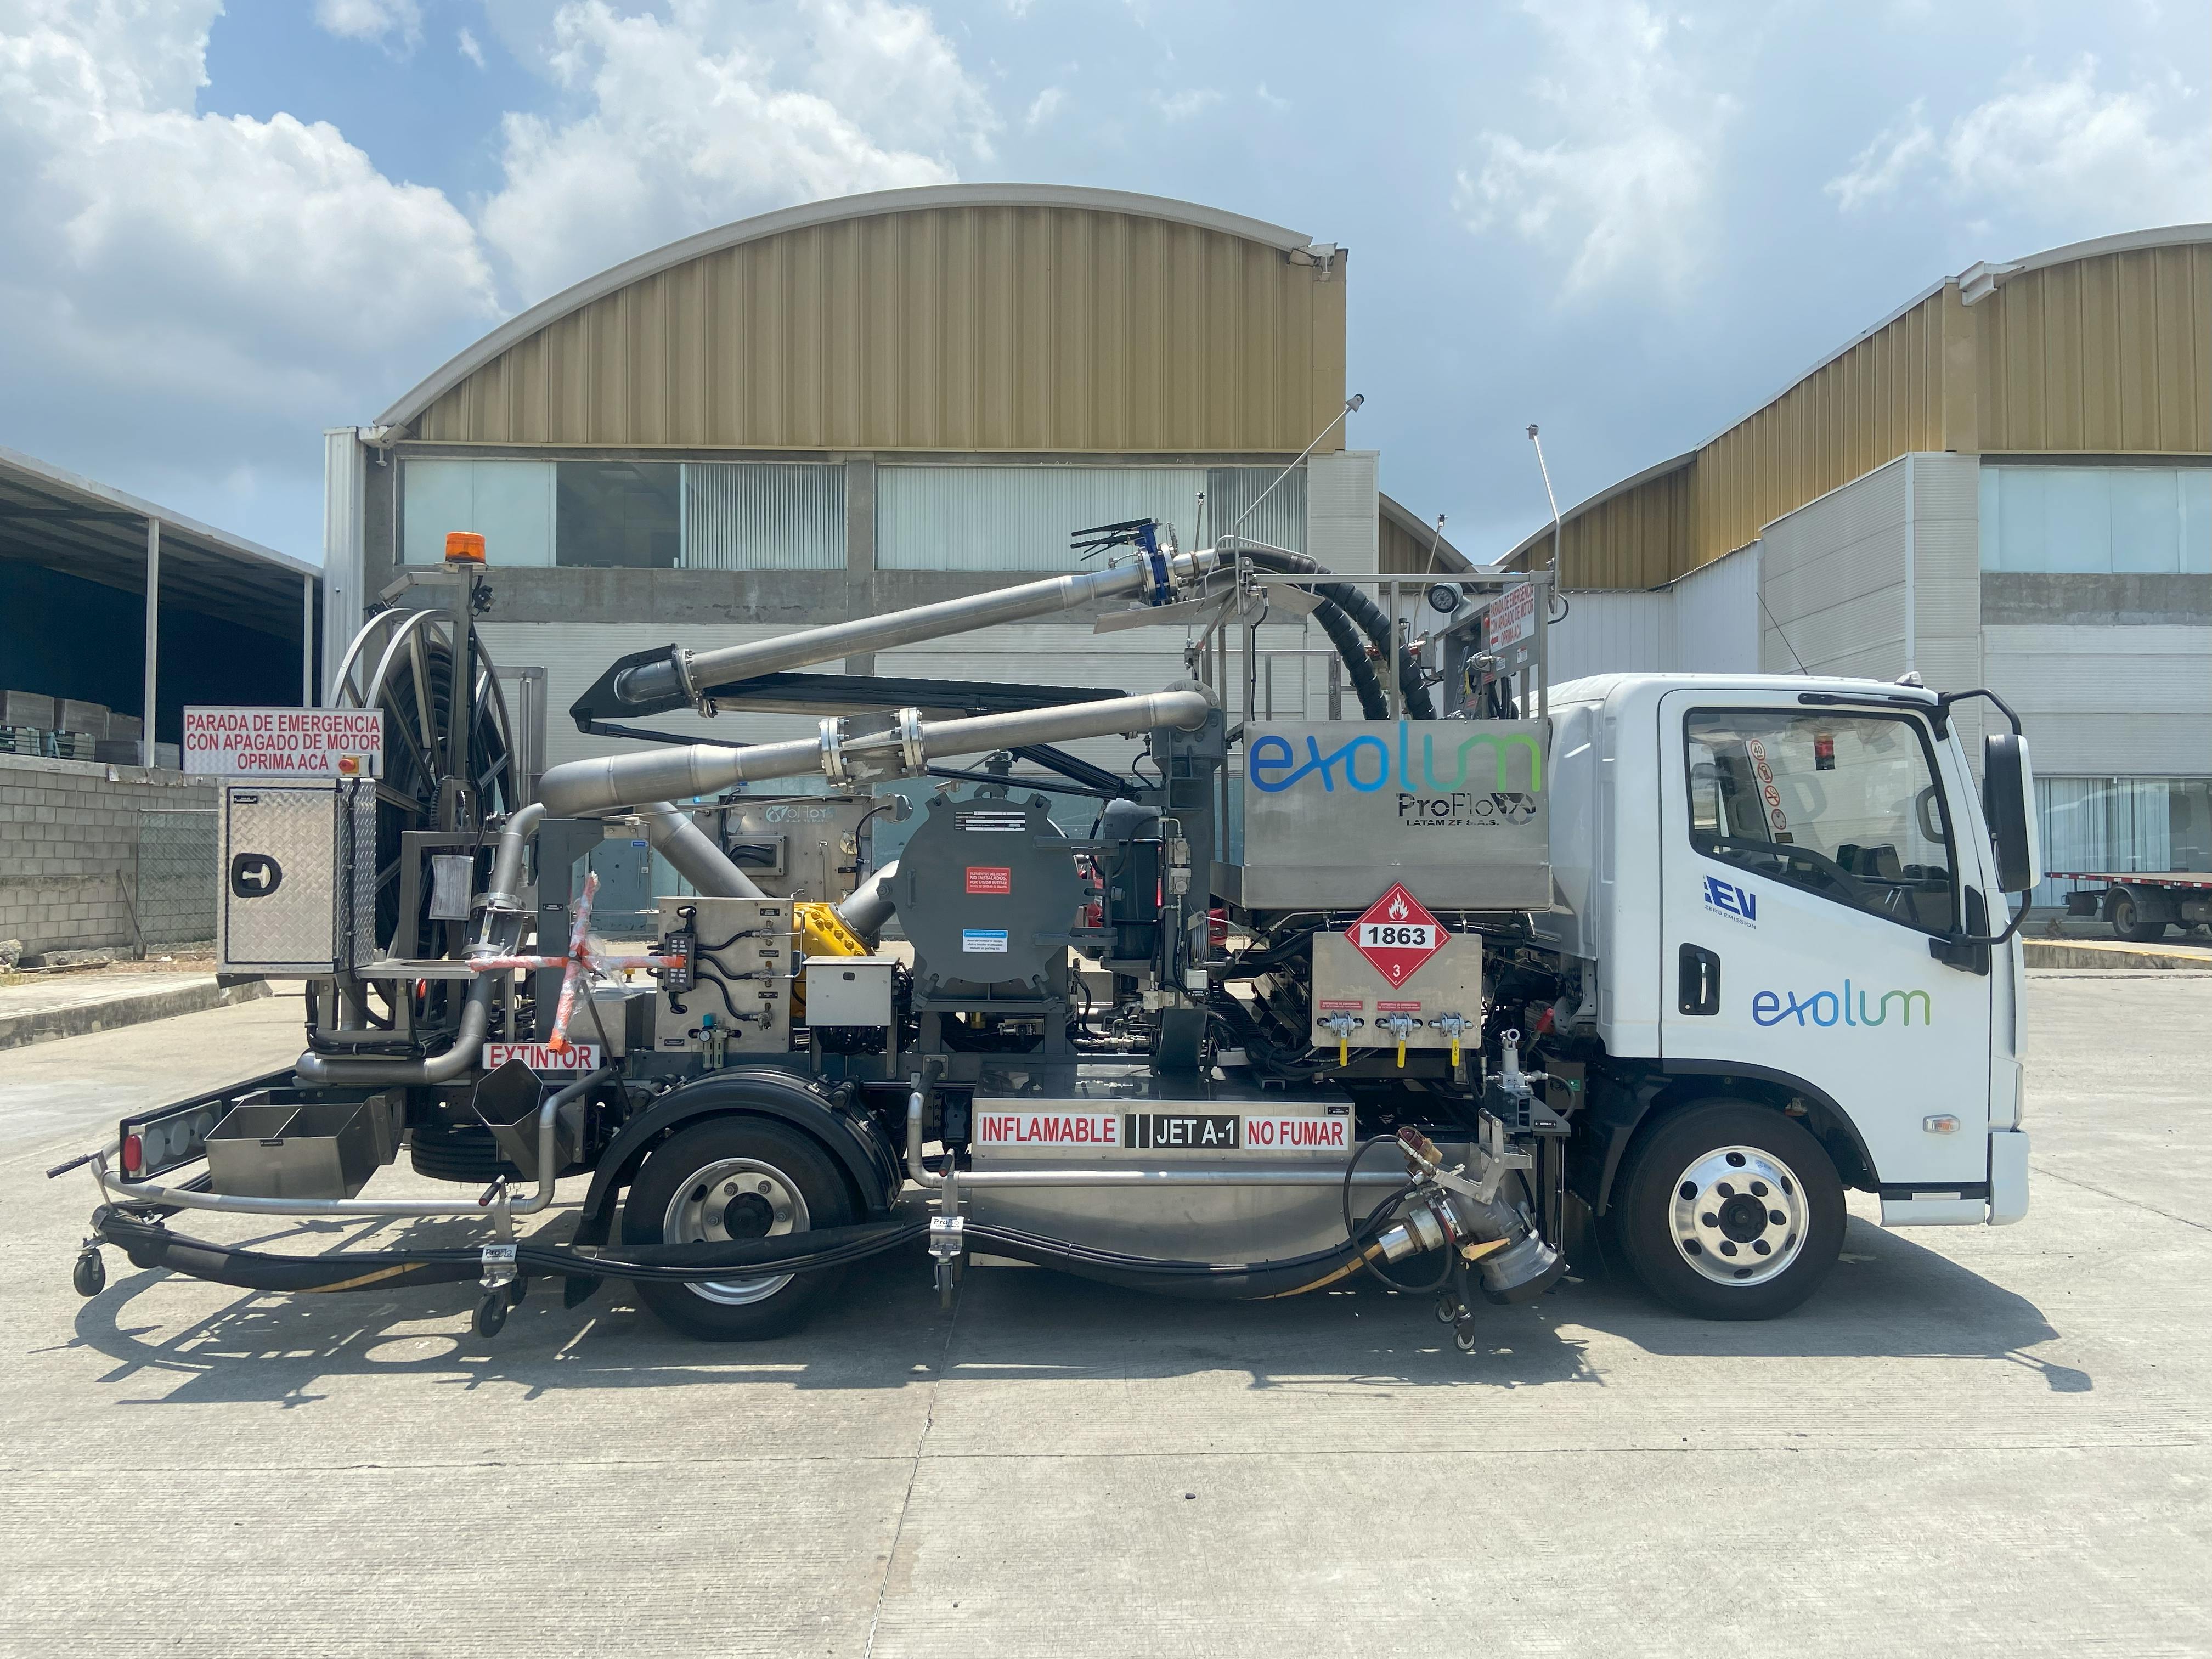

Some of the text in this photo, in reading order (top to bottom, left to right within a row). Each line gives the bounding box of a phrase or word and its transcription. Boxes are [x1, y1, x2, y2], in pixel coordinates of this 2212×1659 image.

[1490, 599, 1503, 617] PARADA
[1504, 594, 1509, 610] DE
[1515, 604, 1520, 621] DE
[1520, 597, 1534, 618] MOTOR
[187, 714, 380, 733] PARADA DE EMERGENCIA
[187, 733, 380, 751] CON APAGADO DE MOTOR
[1754, 746, 1763, 754] 40
[238, 750, 329, 770] OPRIMA ACÁ
[1250, 720, 1541, 792] exolum
[1705, 904, 1756, 929] ZERO EMISSION
[1368, 927, 1426, 945] 1863
[1392, 964, 1400, 977] 3
[1753, 979, 1931, 1027] exolum
[983, 1116, 1115, 1142] INFLAMABLE
[1156, 1119, 1234, 1144] JET A-1
[1248, 1121, 1344, 1146] NO FUMAR
